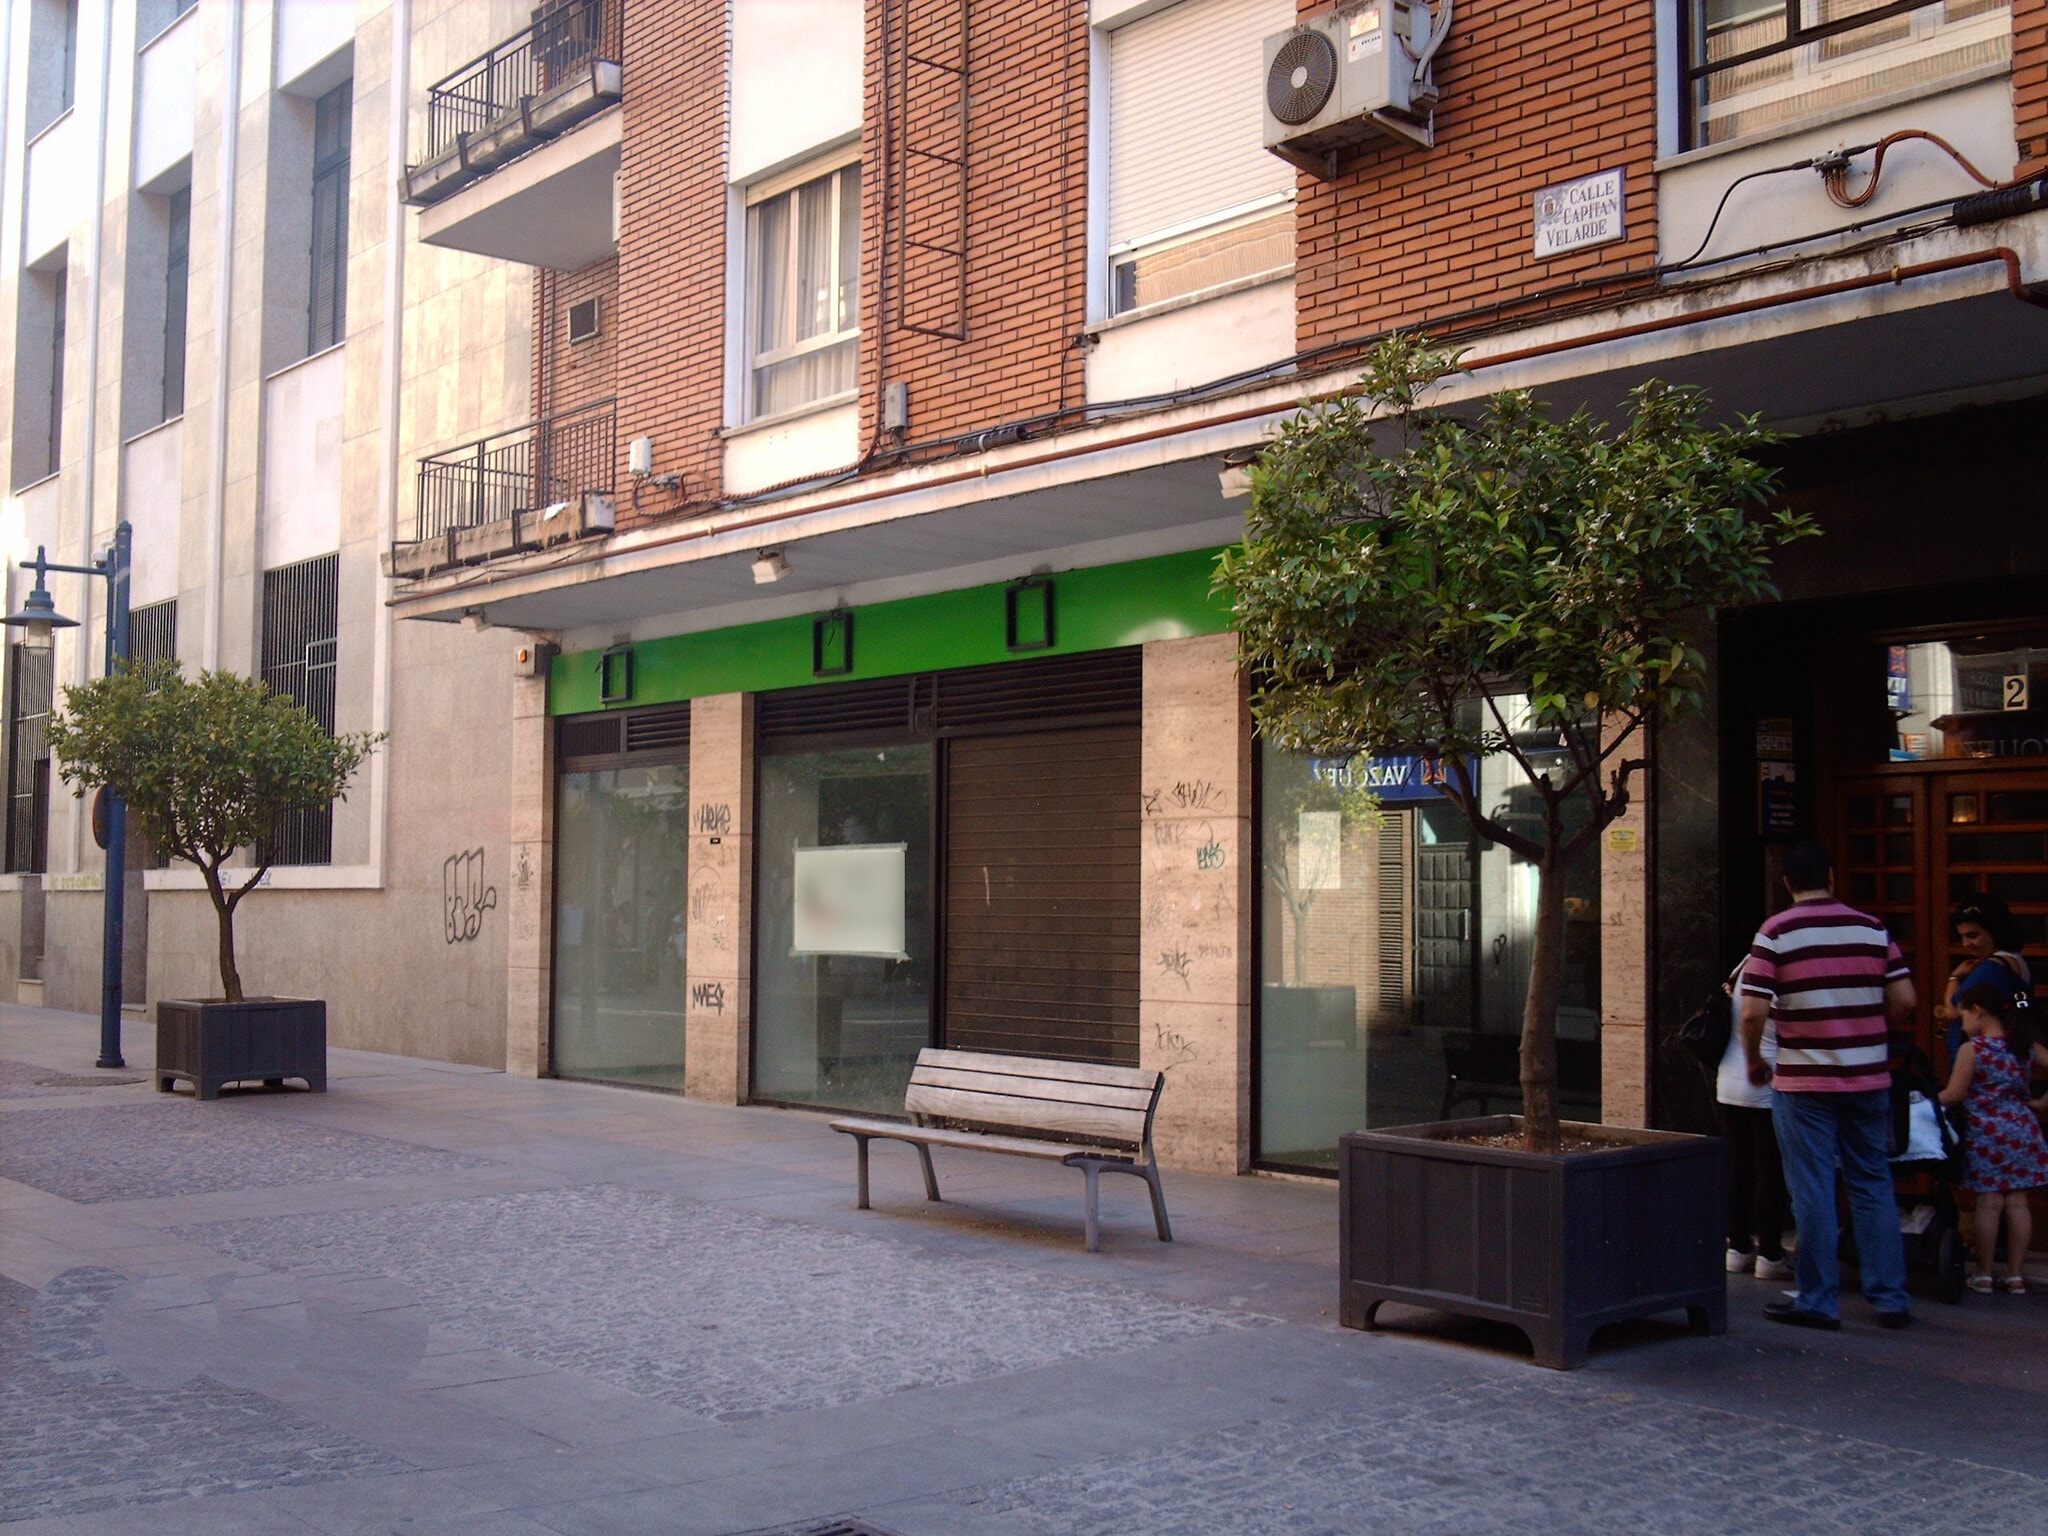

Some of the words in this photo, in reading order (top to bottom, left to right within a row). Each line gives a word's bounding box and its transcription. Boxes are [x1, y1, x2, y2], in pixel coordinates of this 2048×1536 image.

[1570, 180, 1614, 205] CALLE
[1563, 197, 1617, 225] CAPITAN
[1546, 219, 1607, 247] VELARDE
[2006, 678, 2025, 707] 2
